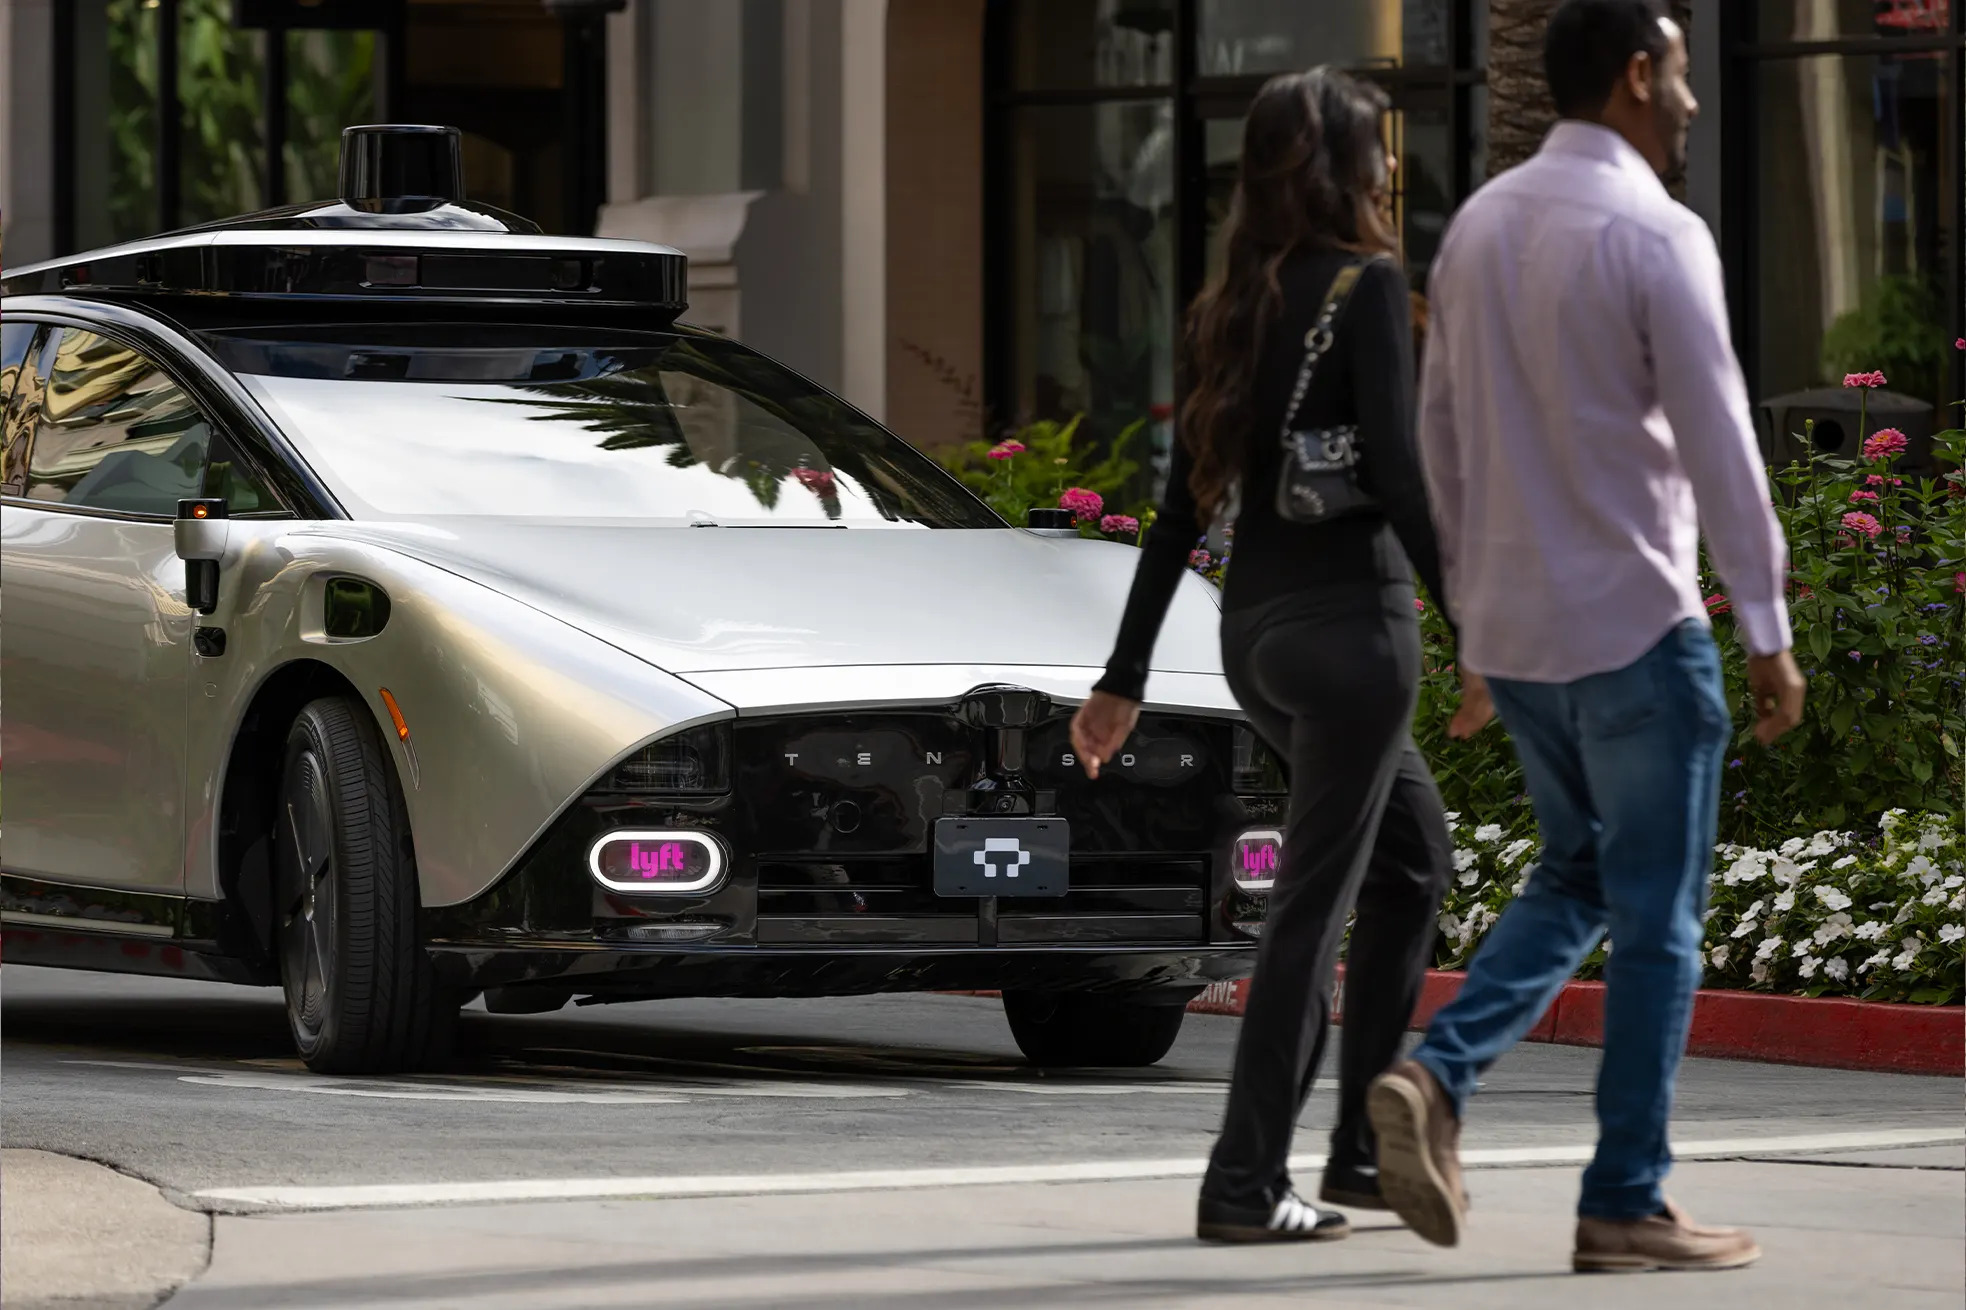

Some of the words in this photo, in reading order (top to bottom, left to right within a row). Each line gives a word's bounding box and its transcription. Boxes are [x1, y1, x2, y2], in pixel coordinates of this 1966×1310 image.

[784, 751, 1194, 767] TENSOR
[631, 842, 684, 879] lyft
[1243, 844, 1275, 878] lyft
